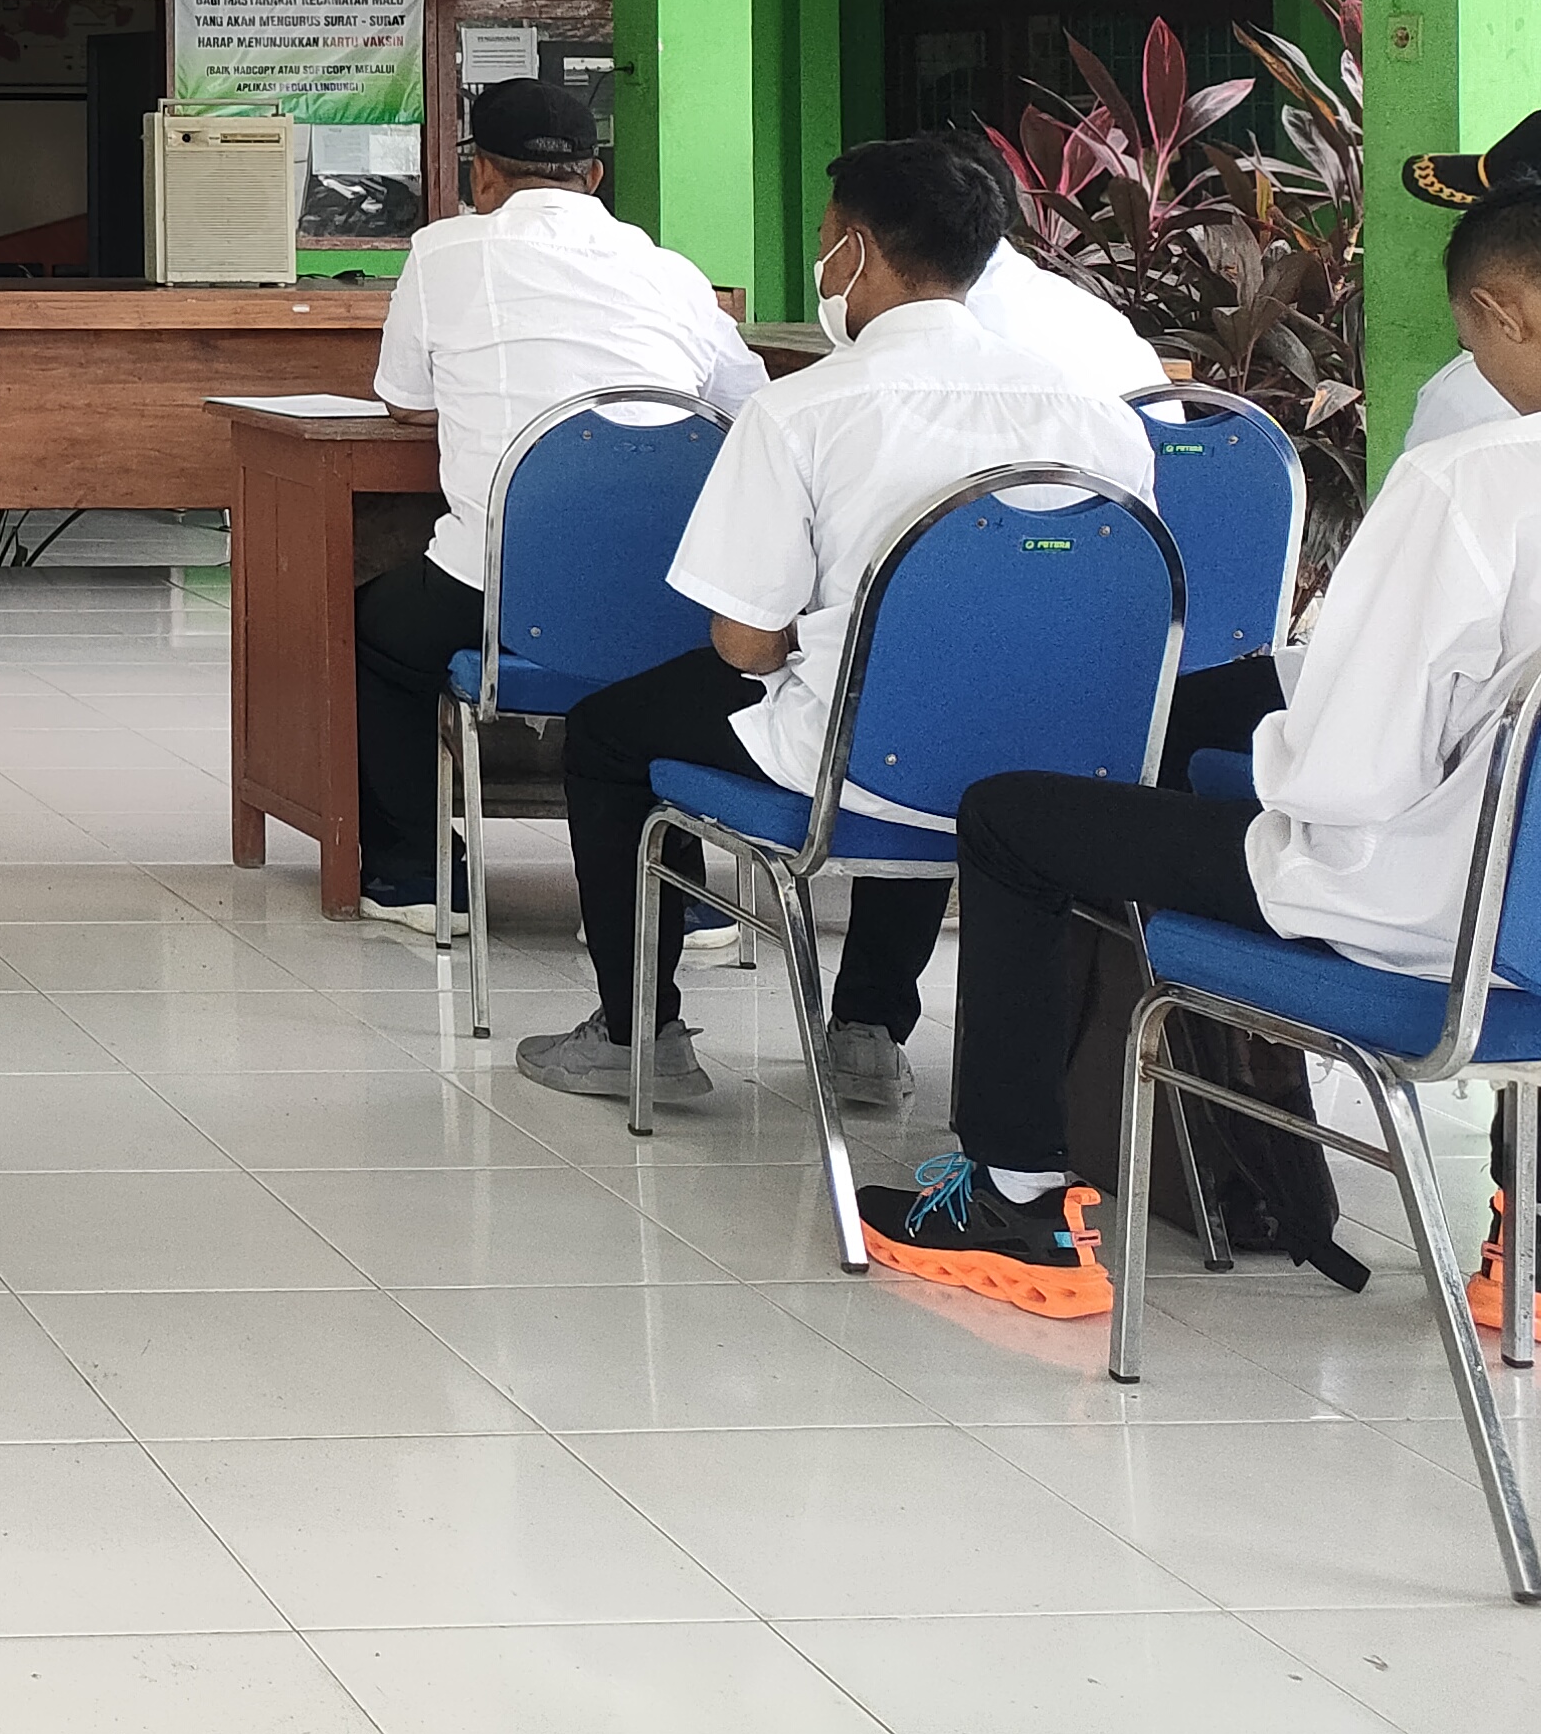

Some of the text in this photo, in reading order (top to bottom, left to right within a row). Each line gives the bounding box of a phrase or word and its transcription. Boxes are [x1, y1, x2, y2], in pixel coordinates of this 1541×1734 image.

[195, 15, 223, 27] YANG
[226, 15, 256, 27] AKAN
[259, 15, 321, 27] MENGURUS
[324, 15, 358, 26] SURAT
[369, 15, 406, 26] SURAT
[198, 35, 404, 48] HARAP MENUNJUKKAN KARTU VAKSIN
[206, 64, 395, 76] (BAIK HADCOPY ATAU SOFTCOPY MELALUI
[236, 82, 359, 92] APLIKASI PEDULI LINDUNGI
